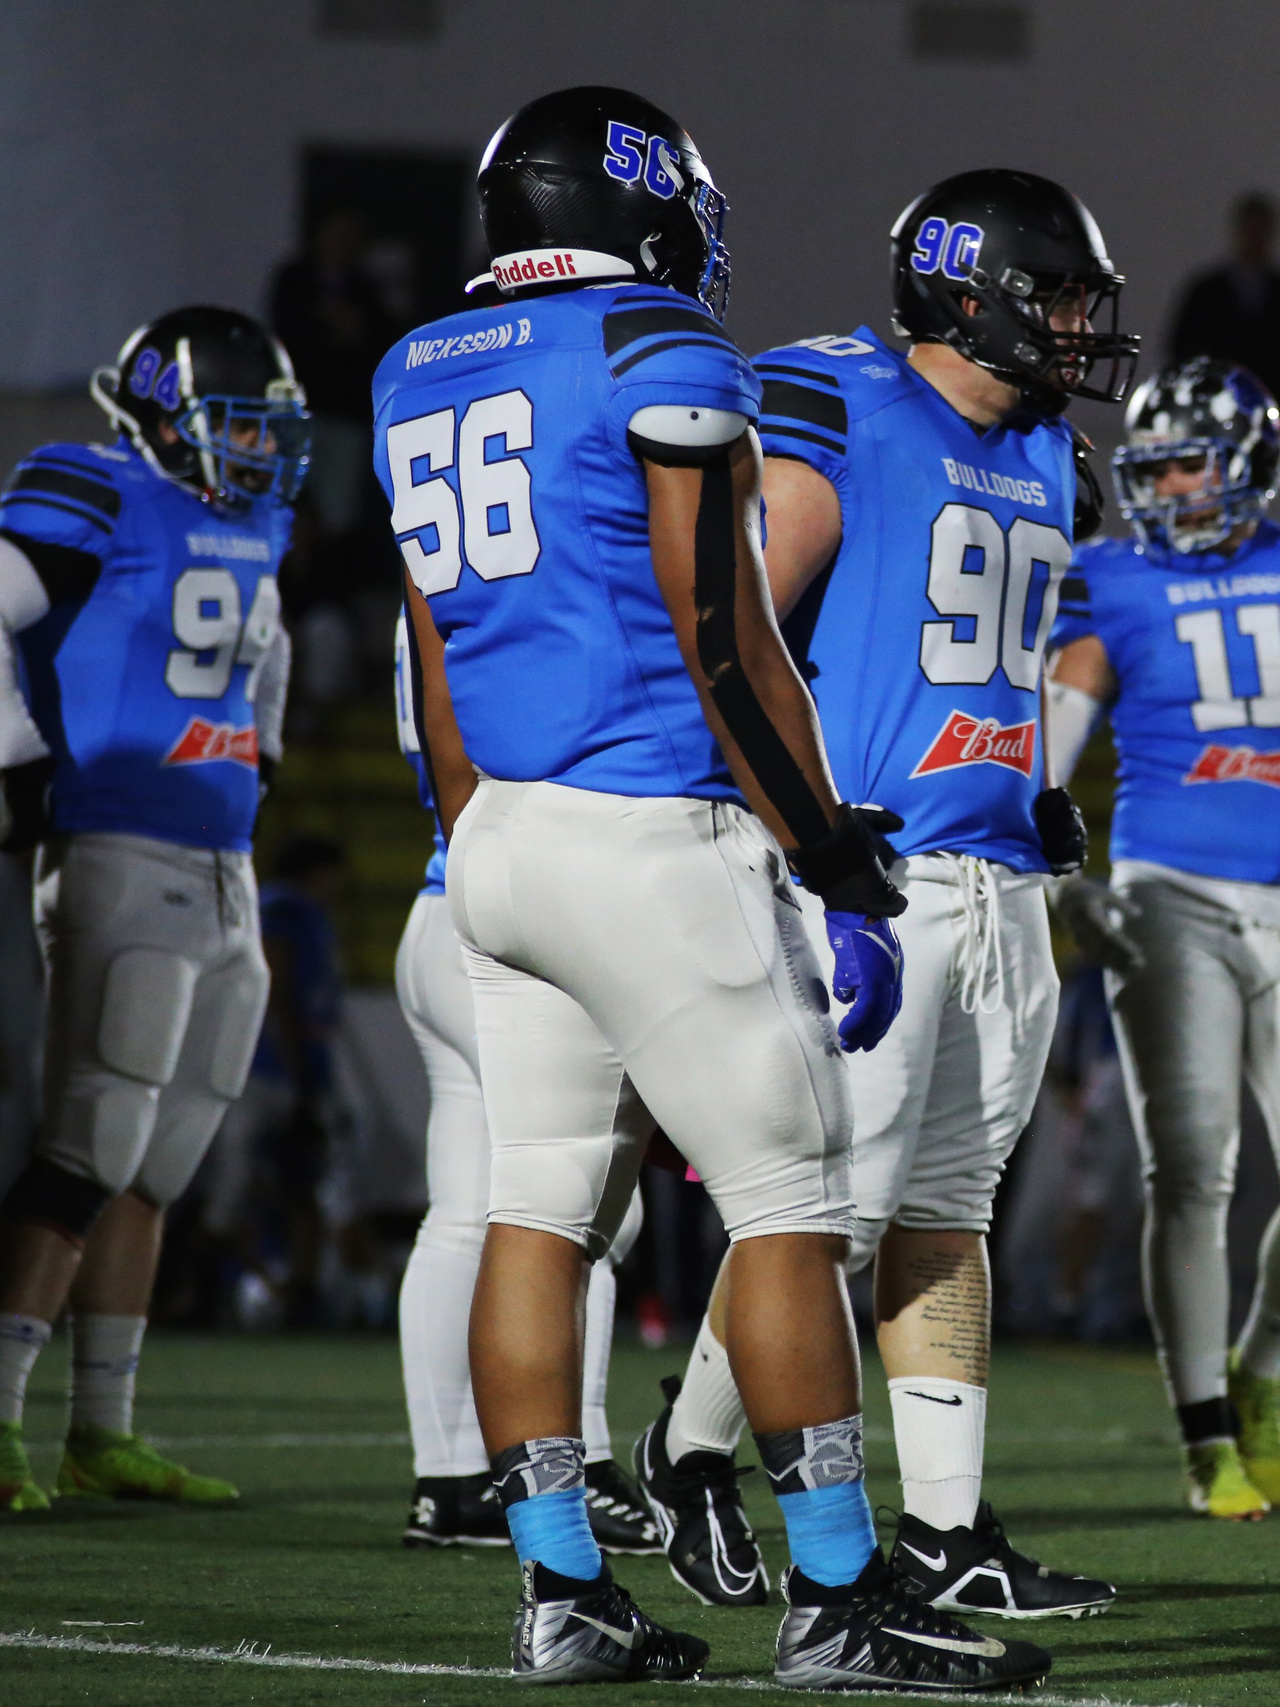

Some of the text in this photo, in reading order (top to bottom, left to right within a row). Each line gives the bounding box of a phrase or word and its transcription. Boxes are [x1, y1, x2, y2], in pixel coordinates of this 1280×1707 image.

[602, 120, 680, 200] 56
[493, 254, 577, 288] Riddell
[911, 216, 984, 281] 90
[406, 317, 534, 370] NICKSSON B.
[129, 347, 181, 412] 94
[386, 387, 542, 598] 56
[941, 458, 1047, 507] BULLDOGS
[918, 502, 1072, 693] 90
[952, 718, 1026, 761] Bud
[523, 1570, 533, 1646] ALPHA MENACE
